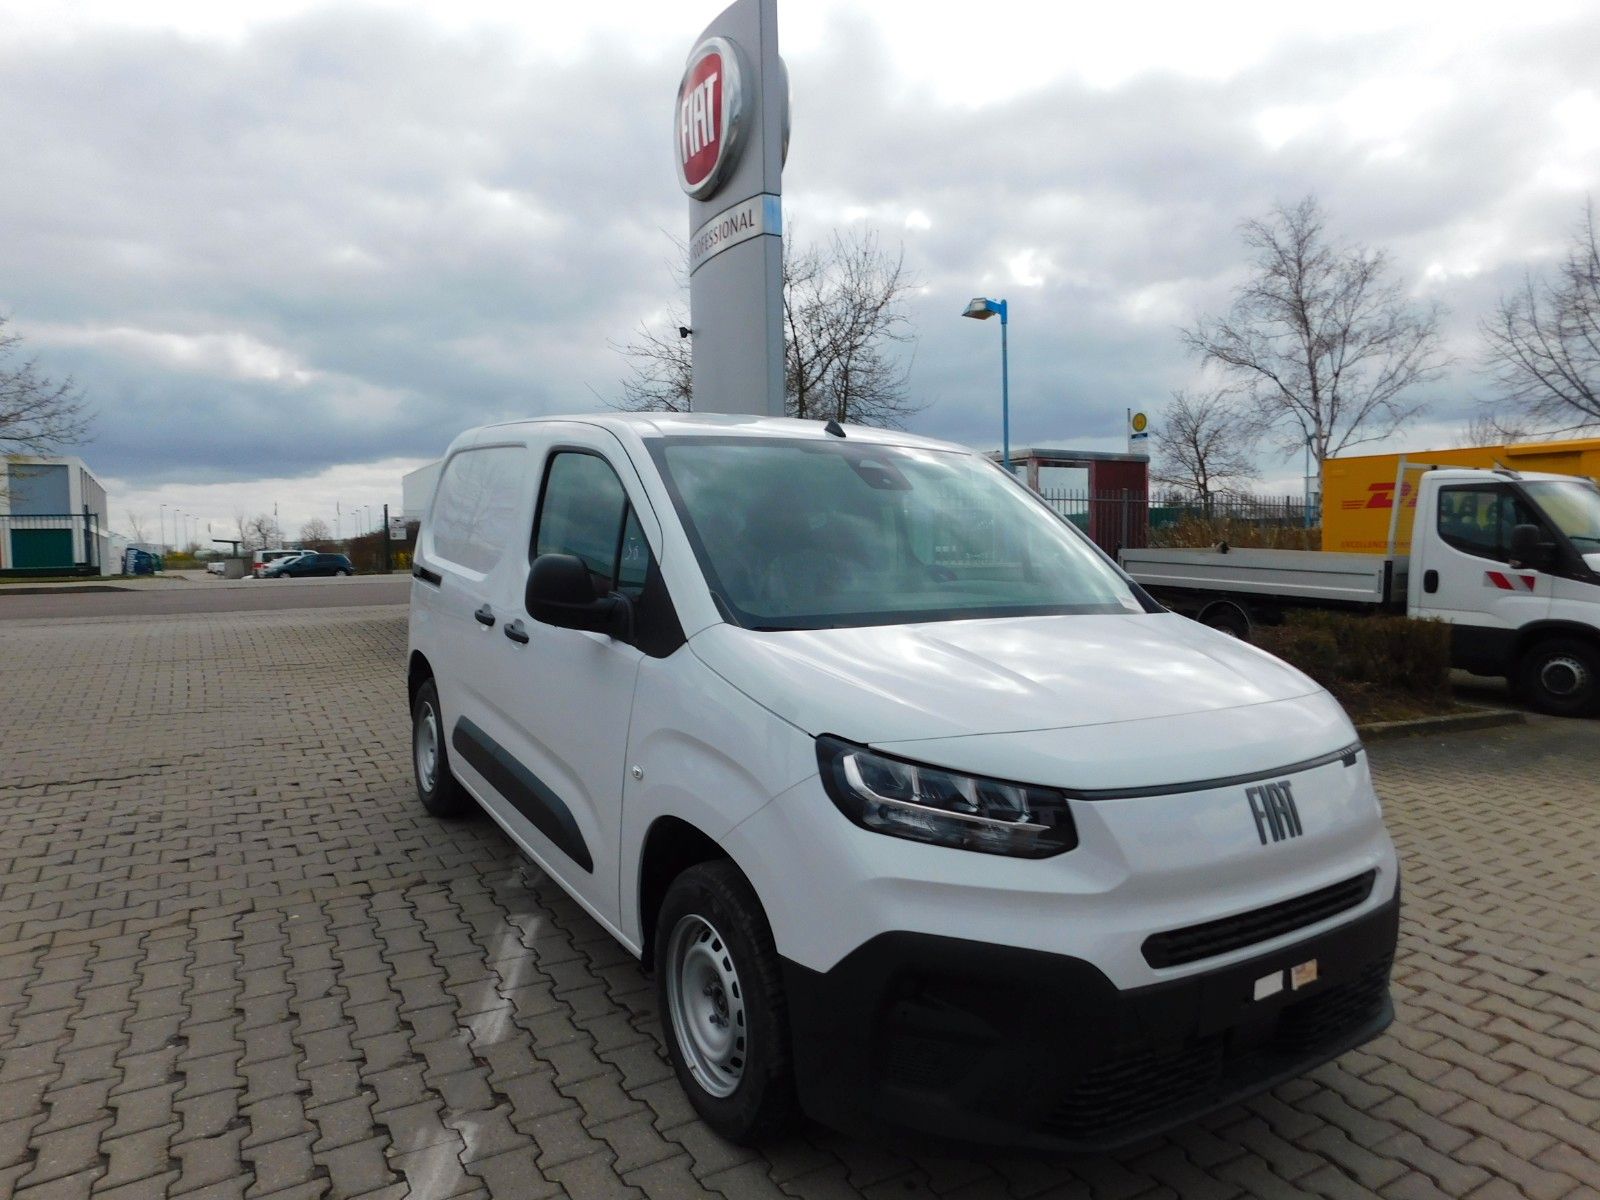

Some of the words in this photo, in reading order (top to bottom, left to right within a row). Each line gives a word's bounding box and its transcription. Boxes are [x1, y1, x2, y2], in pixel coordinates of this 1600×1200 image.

[680, 72, 718, 164] FIAT
[691, 208, 755, 260] ROFESSIONAL
[1245, 780, 1303, 845] FIAT
